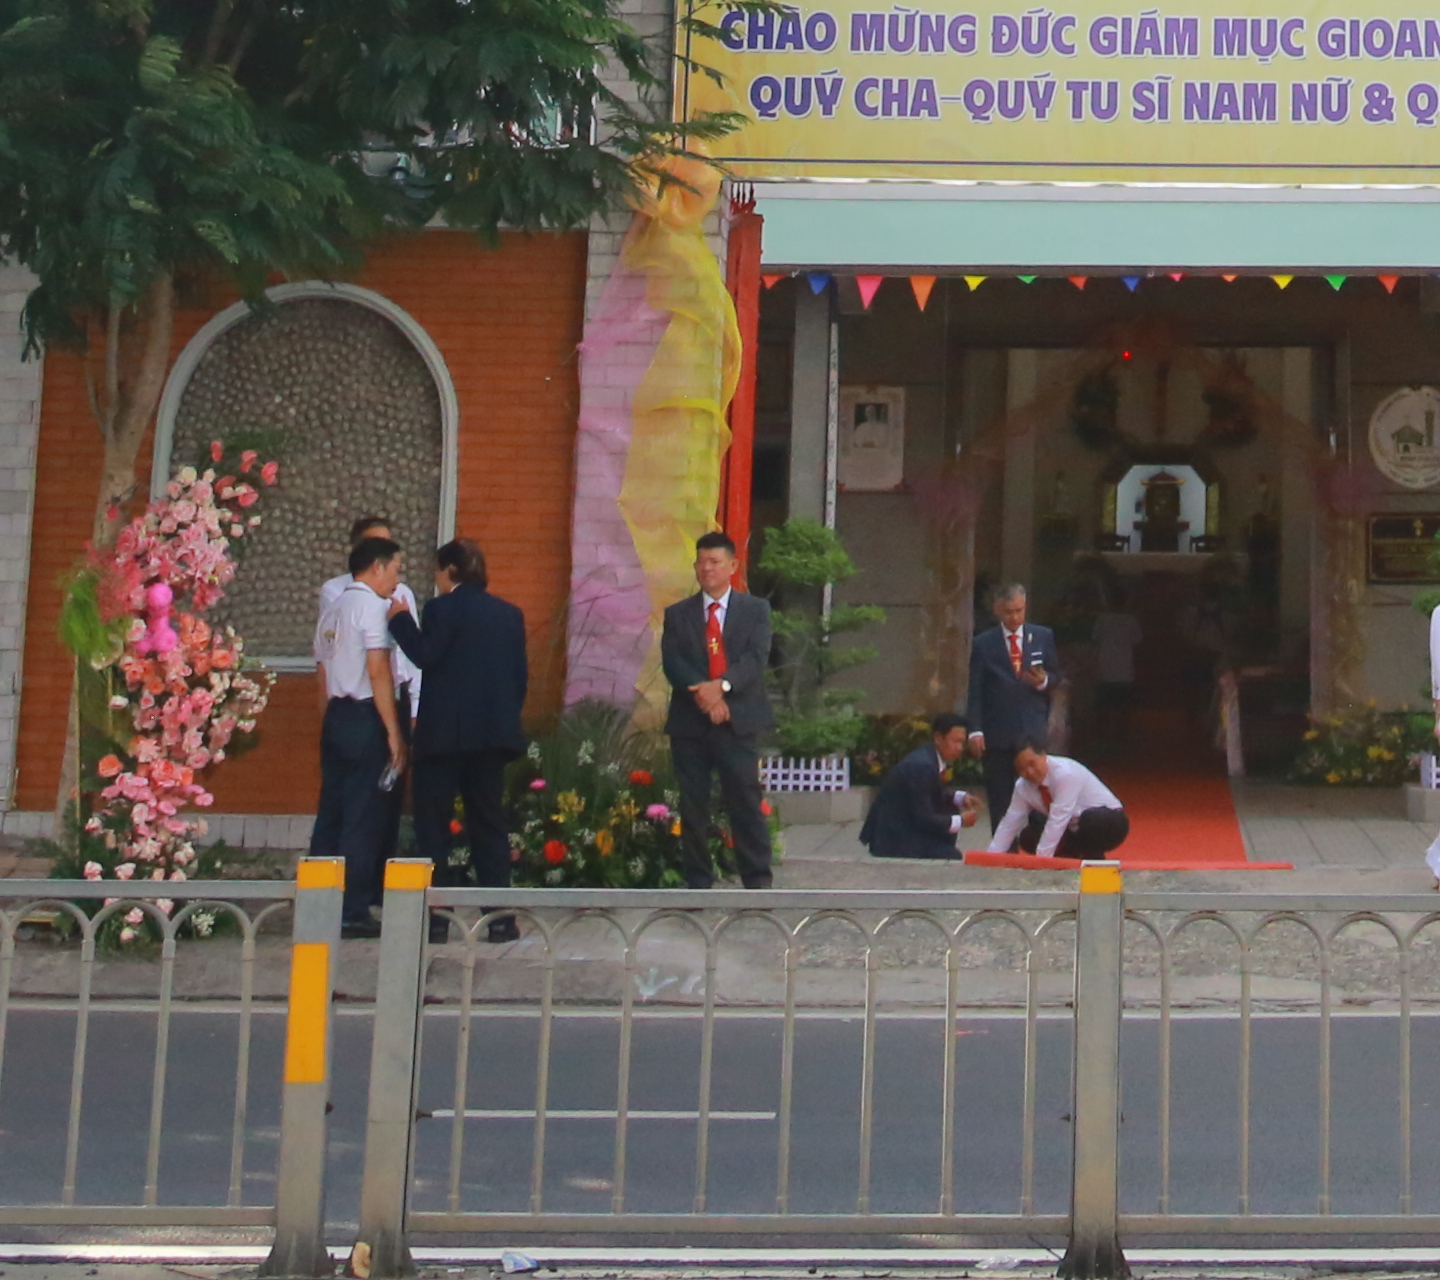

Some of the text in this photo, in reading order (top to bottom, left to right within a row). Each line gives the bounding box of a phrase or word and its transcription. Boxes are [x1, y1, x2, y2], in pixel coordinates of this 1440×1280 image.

[719, 4, 838, 52] CHÀO
[849, 5, 978, 55] MỪNG
[989, 7, 1078, 57] ĐỨC
[1087, 8, 1200, 58] GIÁM
[1211, 16, 1306, 64] MỤC
[748, 68, 845, 120] QUÝ
[1064, 78, 1120, 121] TU
[1130, 74, 1173, 122] SĨ
[1181, 81, 1279, 123] NAM
[1289, 75, 1353, 124] NỮ
[1361, 82, 1396, 124] &
